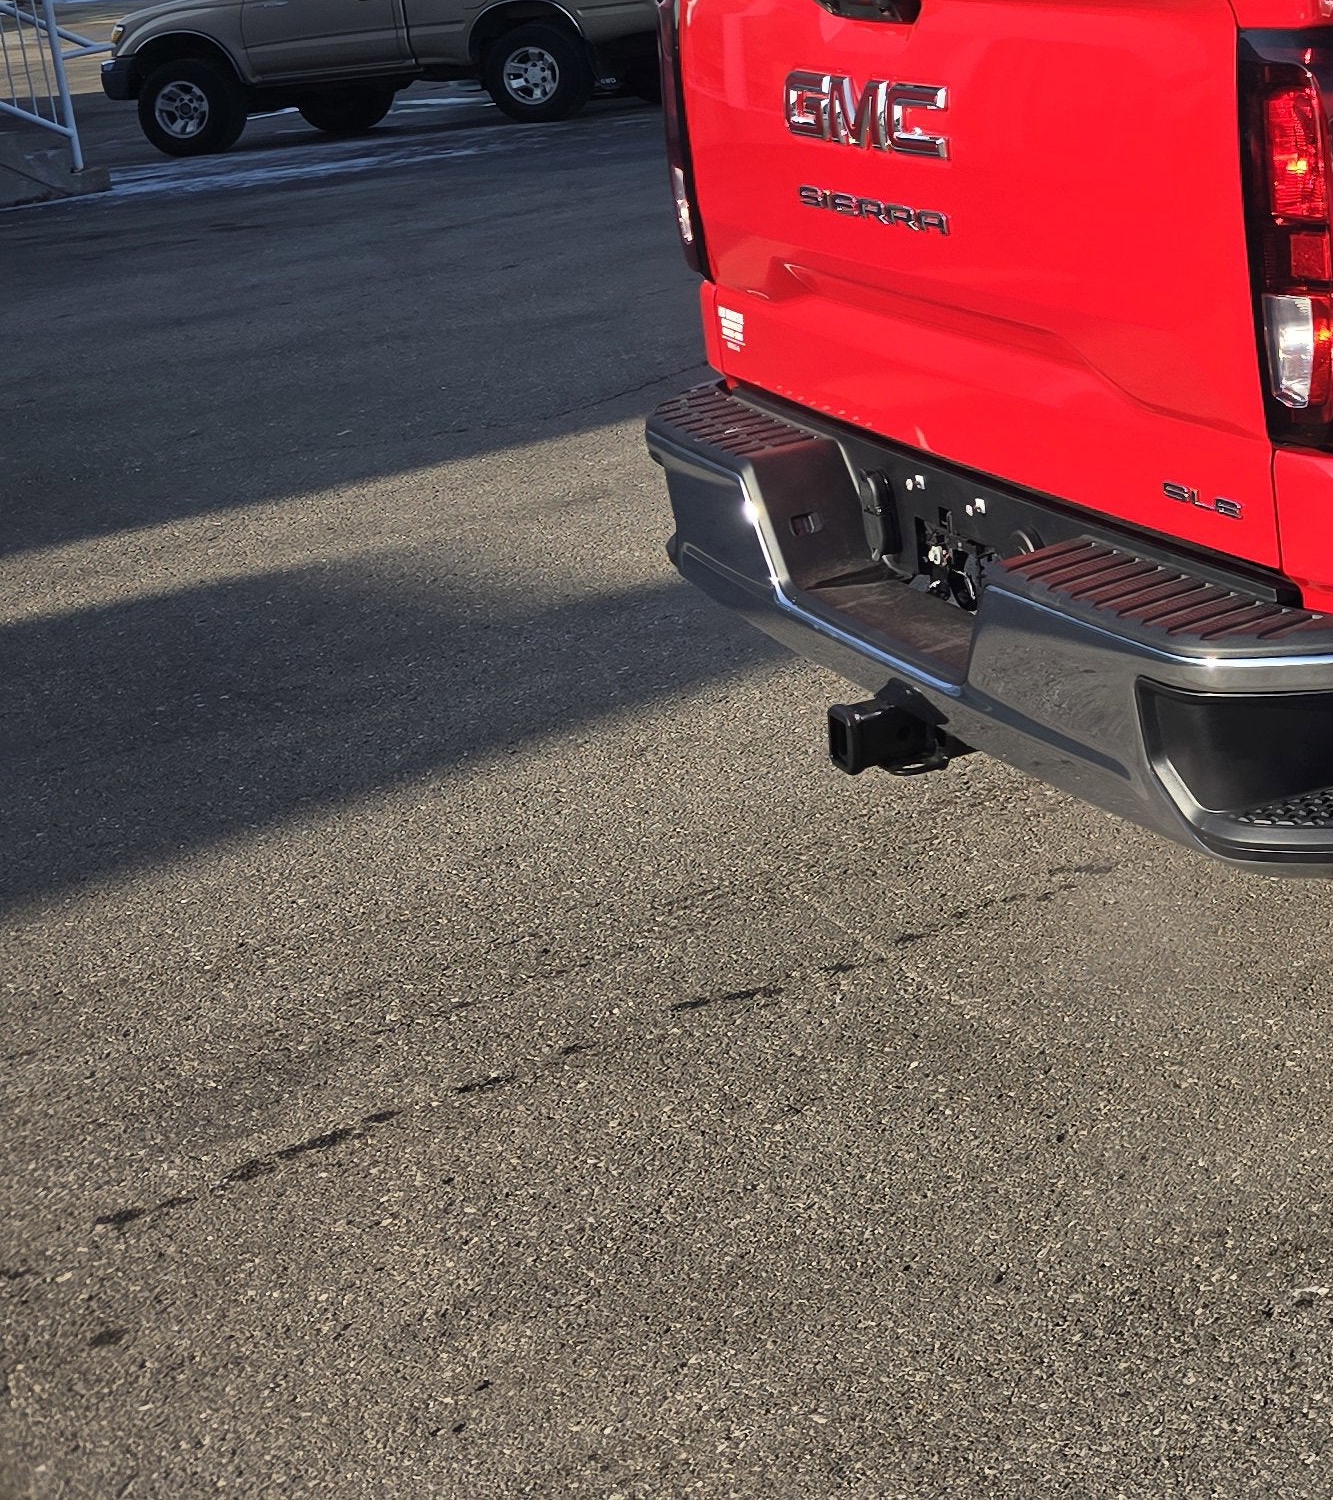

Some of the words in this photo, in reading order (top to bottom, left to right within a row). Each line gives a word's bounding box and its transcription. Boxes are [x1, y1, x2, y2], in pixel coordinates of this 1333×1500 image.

[784, 70, 950, 160] GMC
[799, 185, 950, 236] SIERRA
[1163, 482, 1243, 519] SLE
